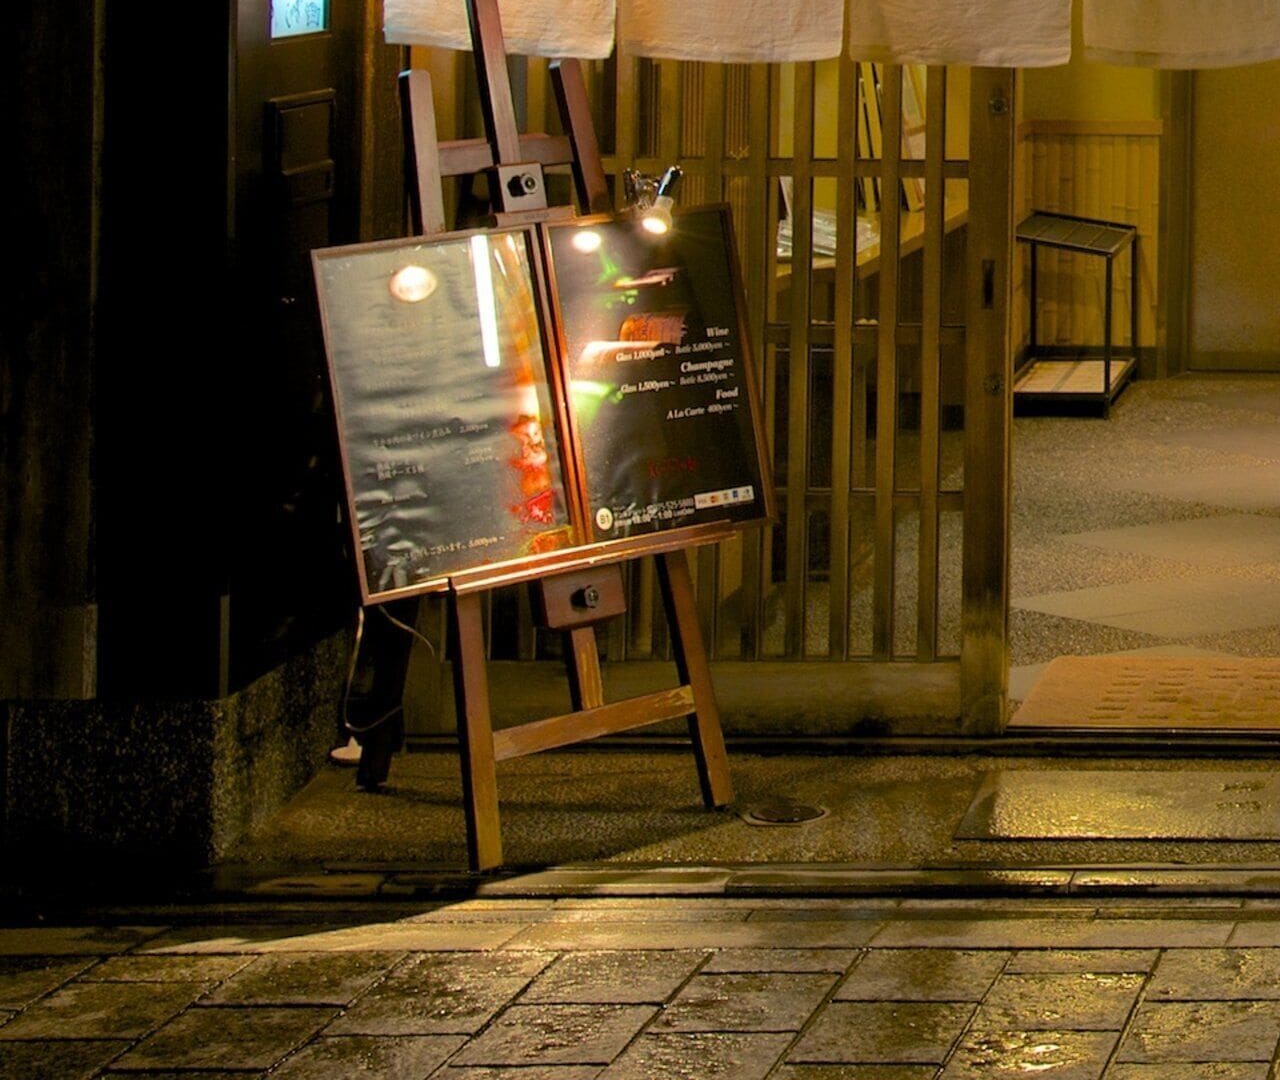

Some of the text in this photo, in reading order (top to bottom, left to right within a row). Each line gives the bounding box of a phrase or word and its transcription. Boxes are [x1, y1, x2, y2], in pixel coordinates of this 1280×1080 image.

[706, 327, 729, 337] Wine
[680, 358, 735, 373] Champagne
[715, 387, 739, 400] Food
